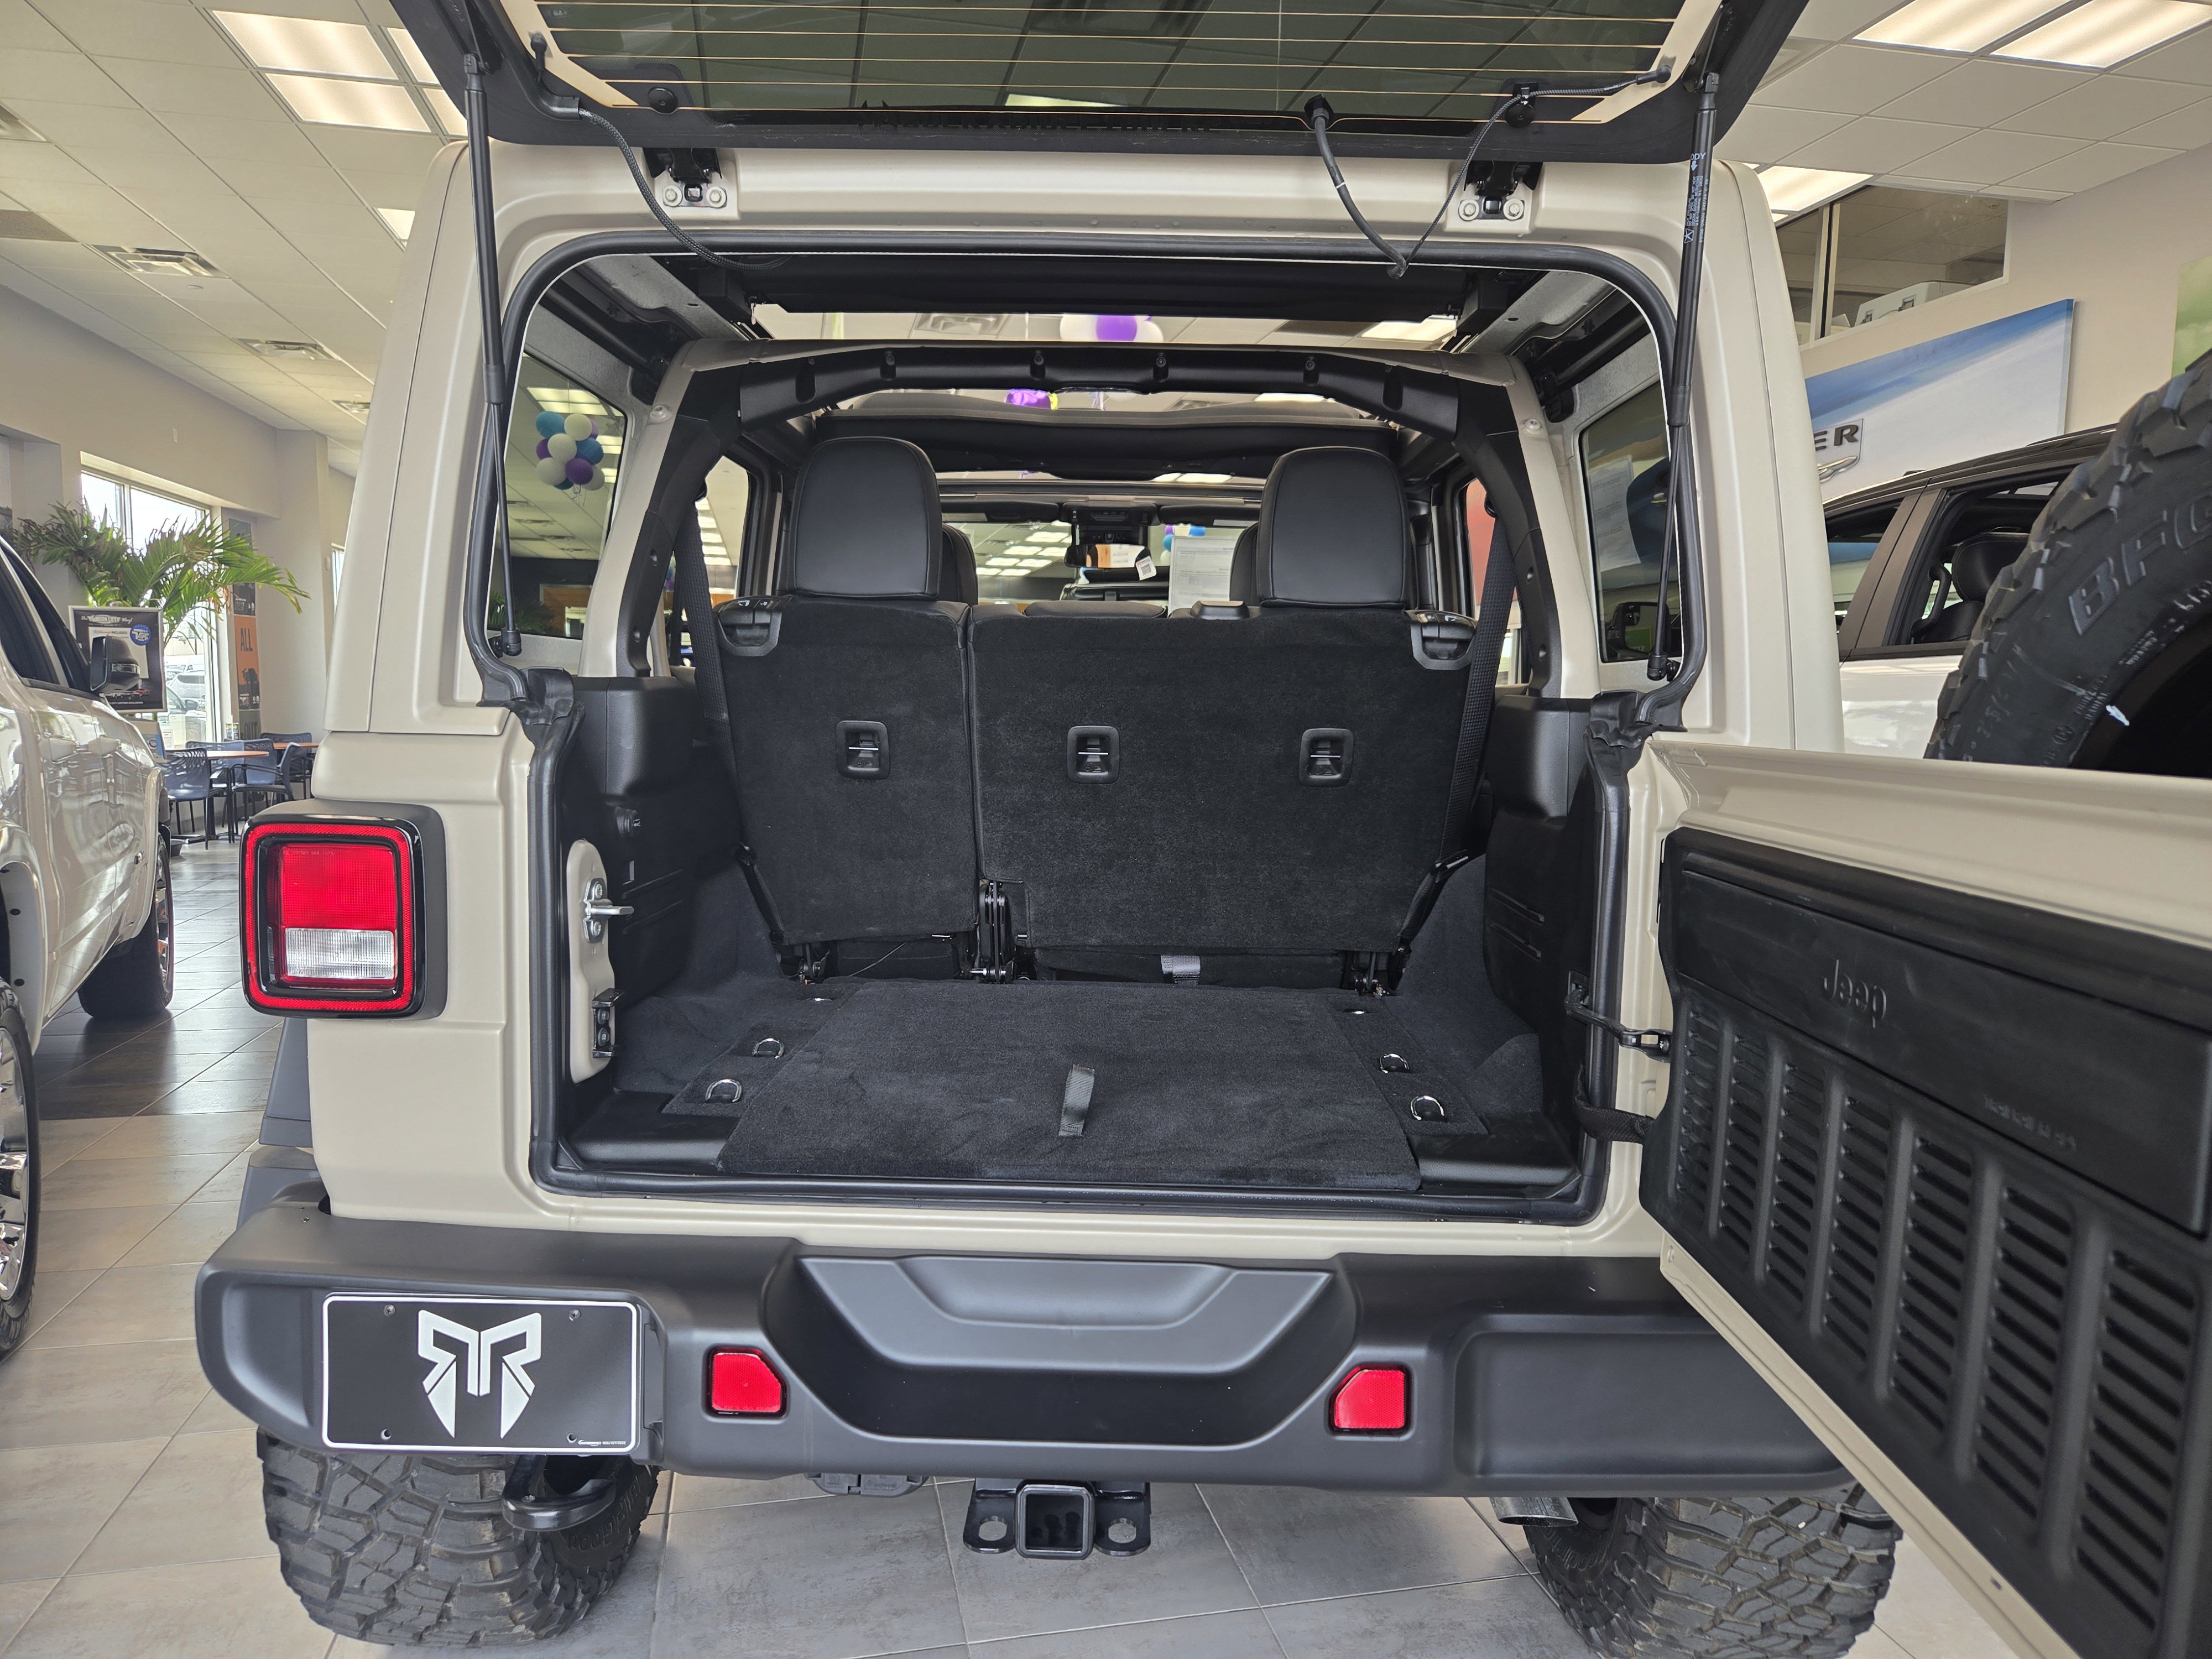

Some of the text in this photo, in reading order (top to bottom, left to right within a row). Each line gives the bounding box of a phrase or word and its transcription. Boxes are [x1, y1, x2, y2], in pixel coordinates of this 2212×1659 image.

[1690, 152, 1706, 160] ODY
[240, 628, 253, 651] ALL
[1820, 958, 1887, 1029] Jeep
